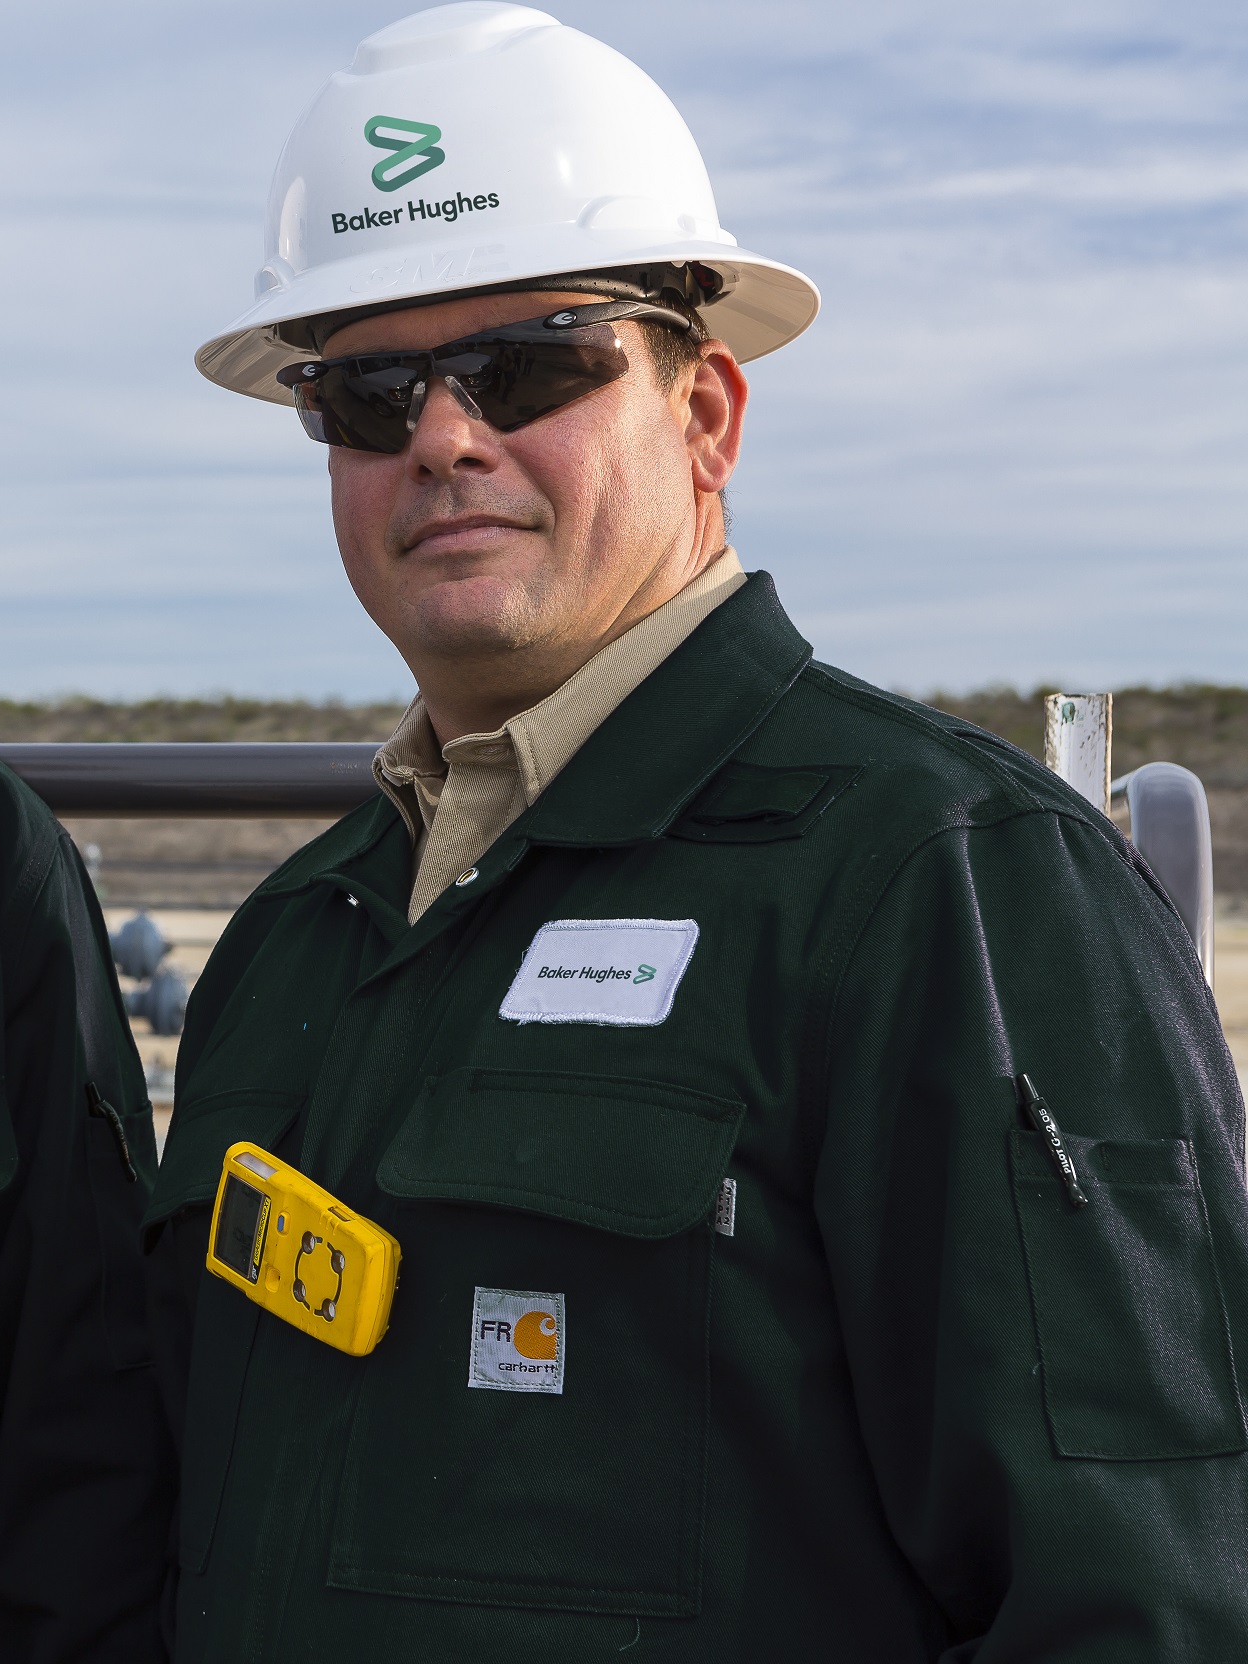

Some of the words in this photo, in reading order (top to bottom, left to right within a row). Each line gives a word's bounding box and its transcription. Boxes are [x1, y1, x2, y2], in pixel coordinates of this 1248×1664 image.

[331, 207, 403, 234] Baker
[407, 192, 500, 222] Hughes
[537, 966, 579, 979] Baker
[578, 966, 632, 983] Hughes
[1045, 1123, 1061, 1147] G-2
[1056, 1149, 1071, 1174] PILOT
[480, 1320, 511, 1342] FR
[498, 1362, 555, 1373] carhartt
